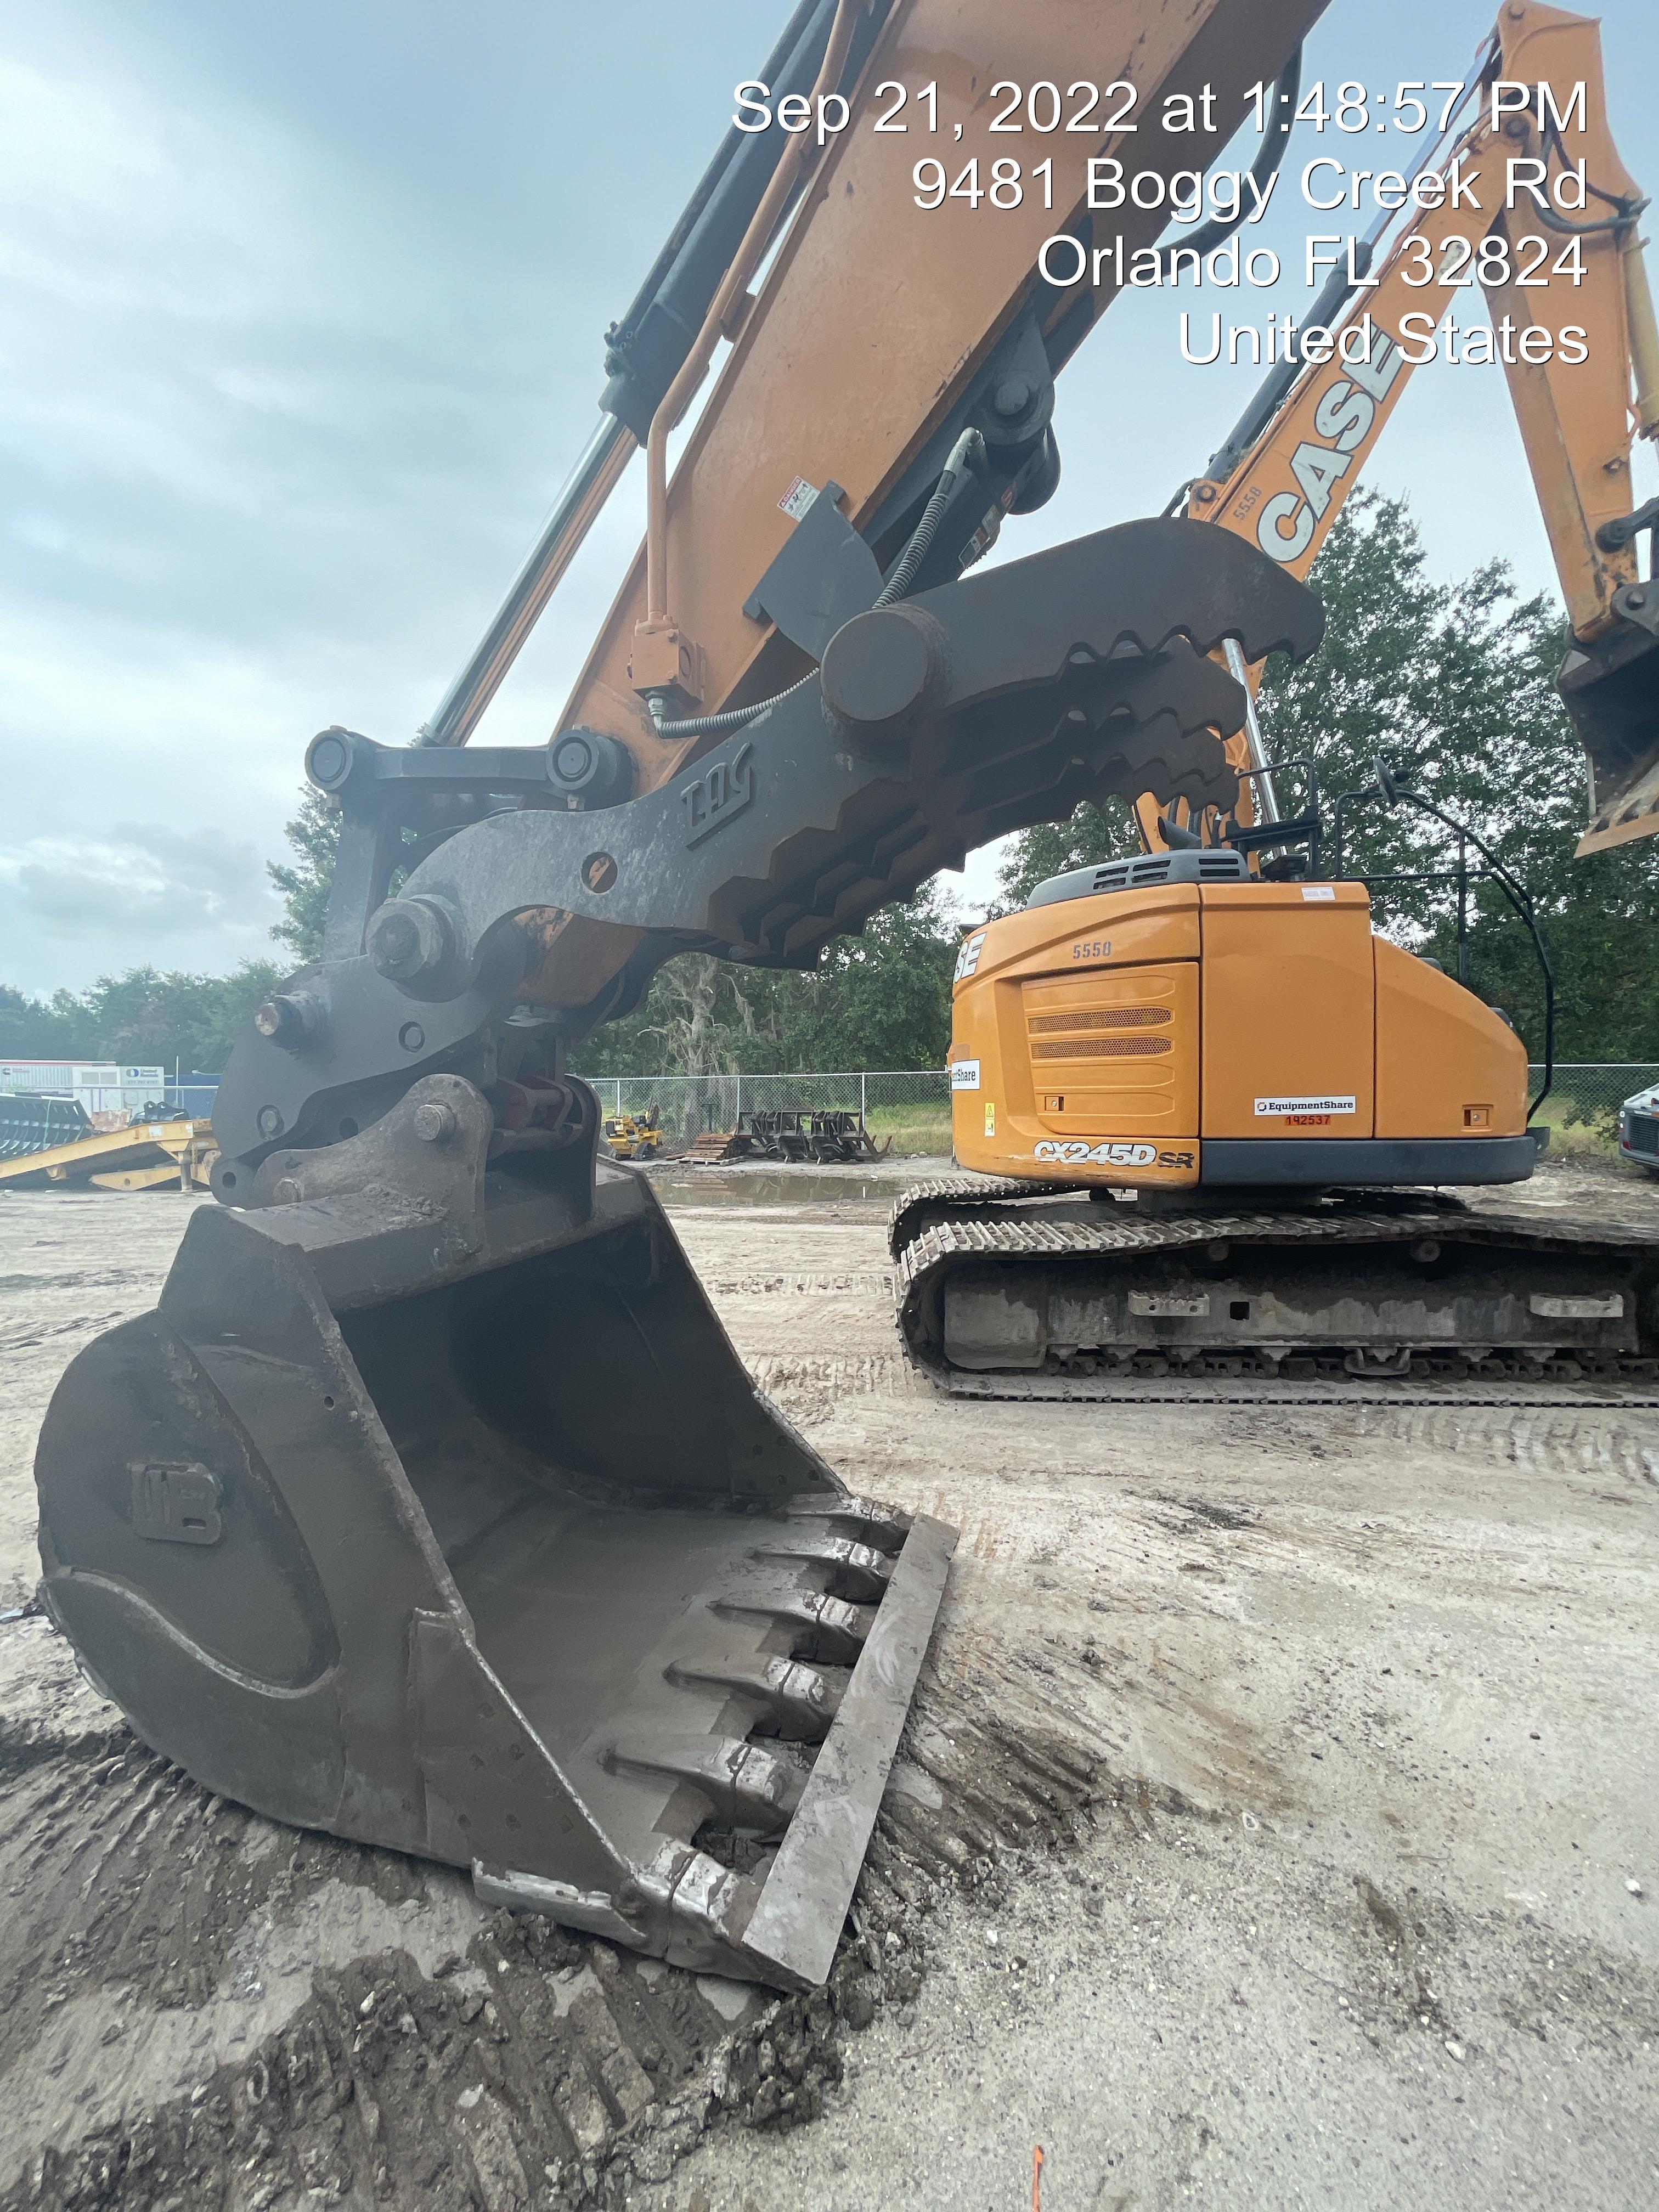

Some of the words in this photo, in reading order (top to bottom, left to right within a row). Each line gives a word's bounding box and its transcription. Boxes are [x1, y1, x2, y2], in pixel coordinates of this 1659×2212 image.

[1256, 320, 1409, 563] CASE
[953, 931, 988, 984] SE
[1073, 941, 1111, 960] 5550
[1268, 1101, 1354, 1111] EquipmentShare
[1034, 1140, 1158, 1166] CX245D
[1158, 1152, 1195, 1169] SR
